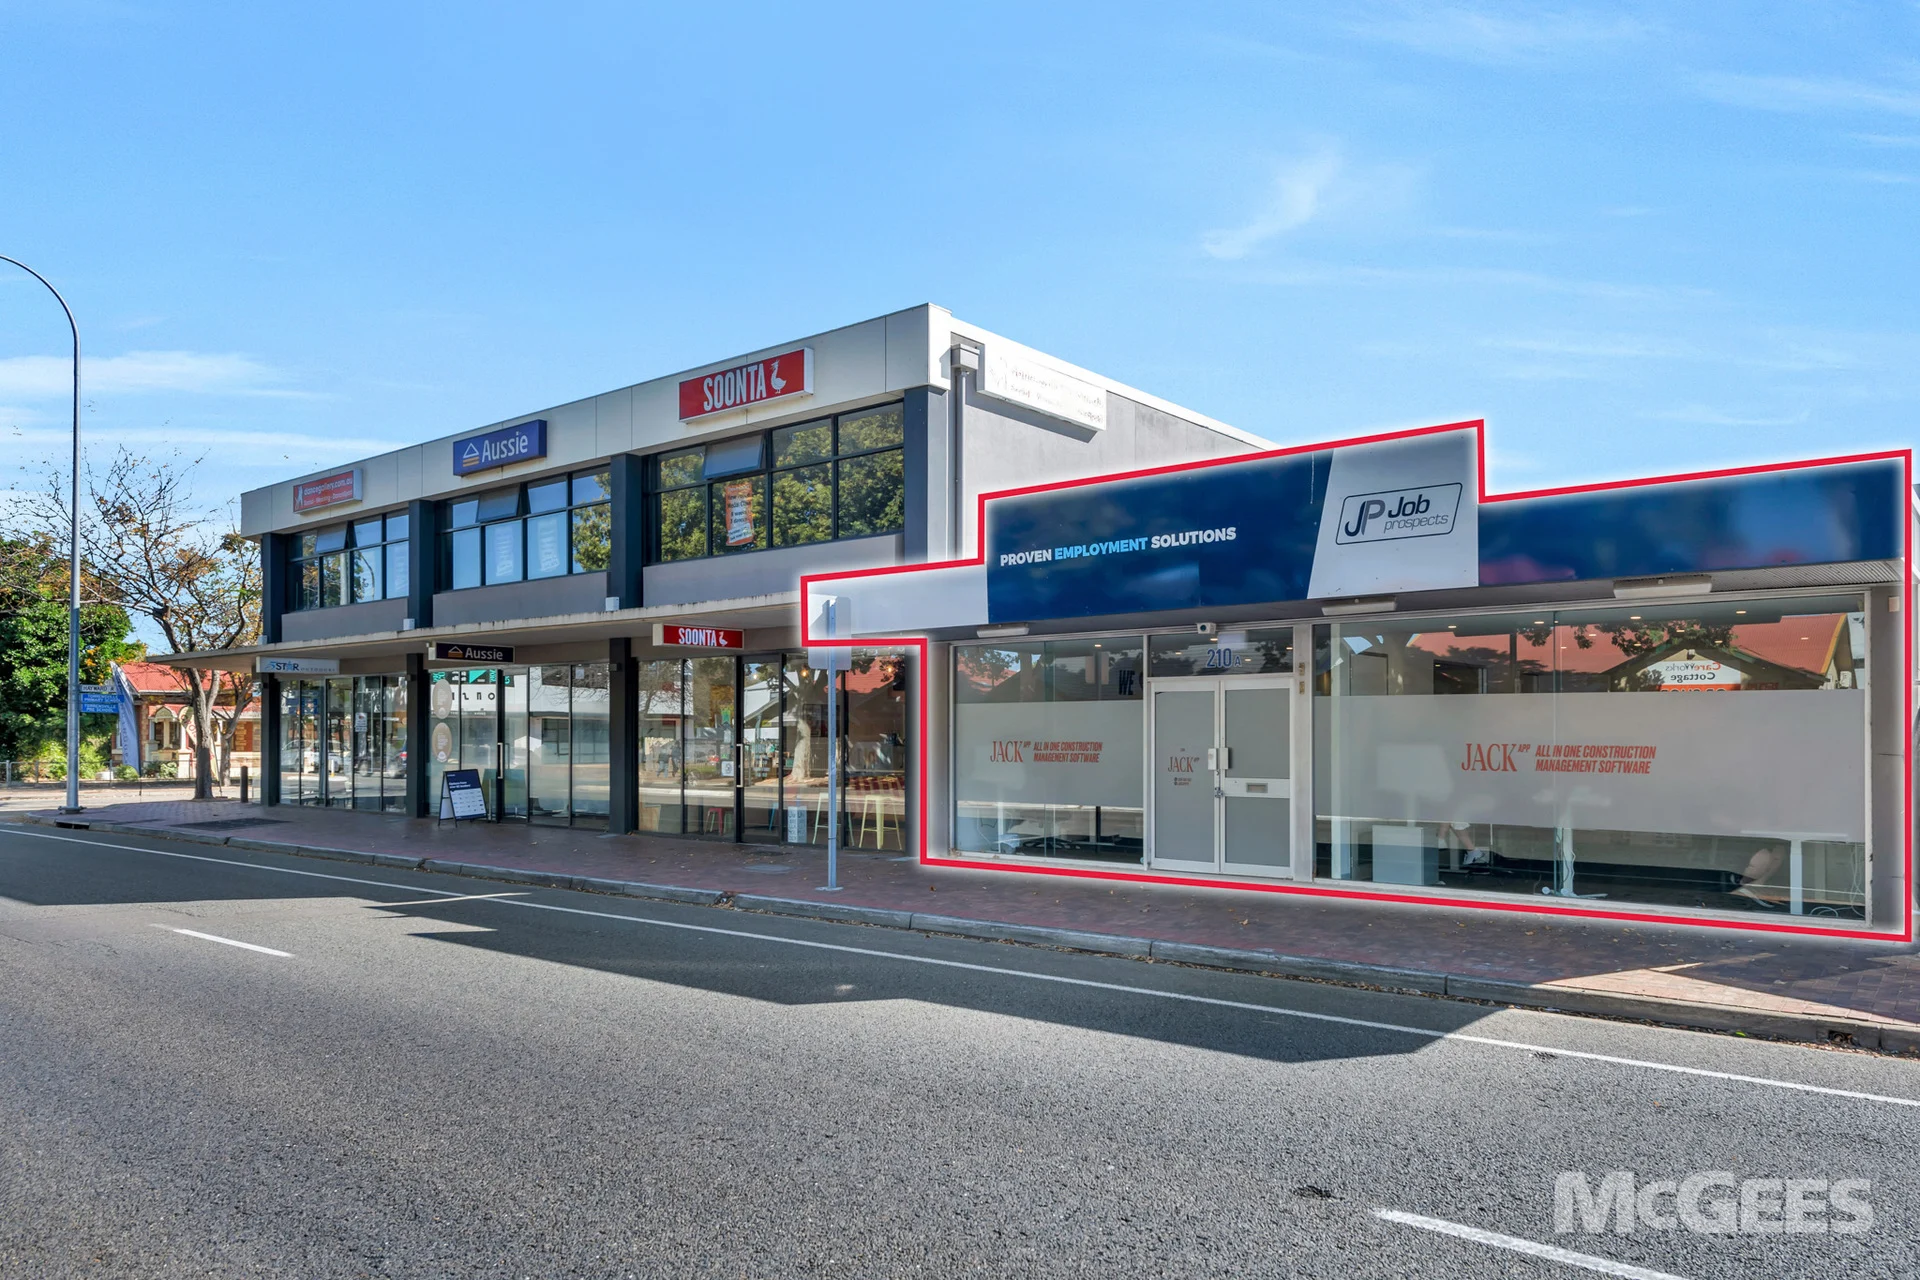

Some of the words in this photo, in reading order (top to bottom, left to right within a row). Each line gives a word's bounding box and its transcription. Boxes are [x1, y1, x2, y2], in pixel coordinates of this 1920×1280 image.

[703, 363, 766, 412] SOONTA
[482, 431, 529, 463] Aussie
[1388, 493, 1431, 519] Job
[1384, 511, 1450, 534] prospects
[999, 548, 1052, 567] PROVEN
[1054, 537, 1148, 560] EMPLOYMENT
[1151, 526, 1237, 549] SOLUTIONS
[678, 627, 717, 647] SOONTA
[464, 647, 504, 661] Aussie
[990, 740, 1023, 763] JACK
[1033, 741, 1043, 752] ALL
[1044, 741, 1049, 752] IN
[1050, 741, 1060, 752] ONE
[1061, 741, 1103, 752] CONSTRUCTION
[1461, 742, 1518, 772] JACK
[1518, 744, 1531, 753] APP
[1535, 745, 1551, 758] ALL
[1553, 745, 1562, 758] IN
[1563, 745, 1582, 759] ONE
[1582, 745, 1656, 760] CONSTRUCTION
[1033, 752, 1069, 763] MANAGEMENT
[1070, 752, 1100, 763] SOFTWARE
[1167, 756, 1194, 773] JACK
[1535, 759, 1598, 774] MANAGEMENT
[1598, 760, 1651, 775] SOFTWARE
